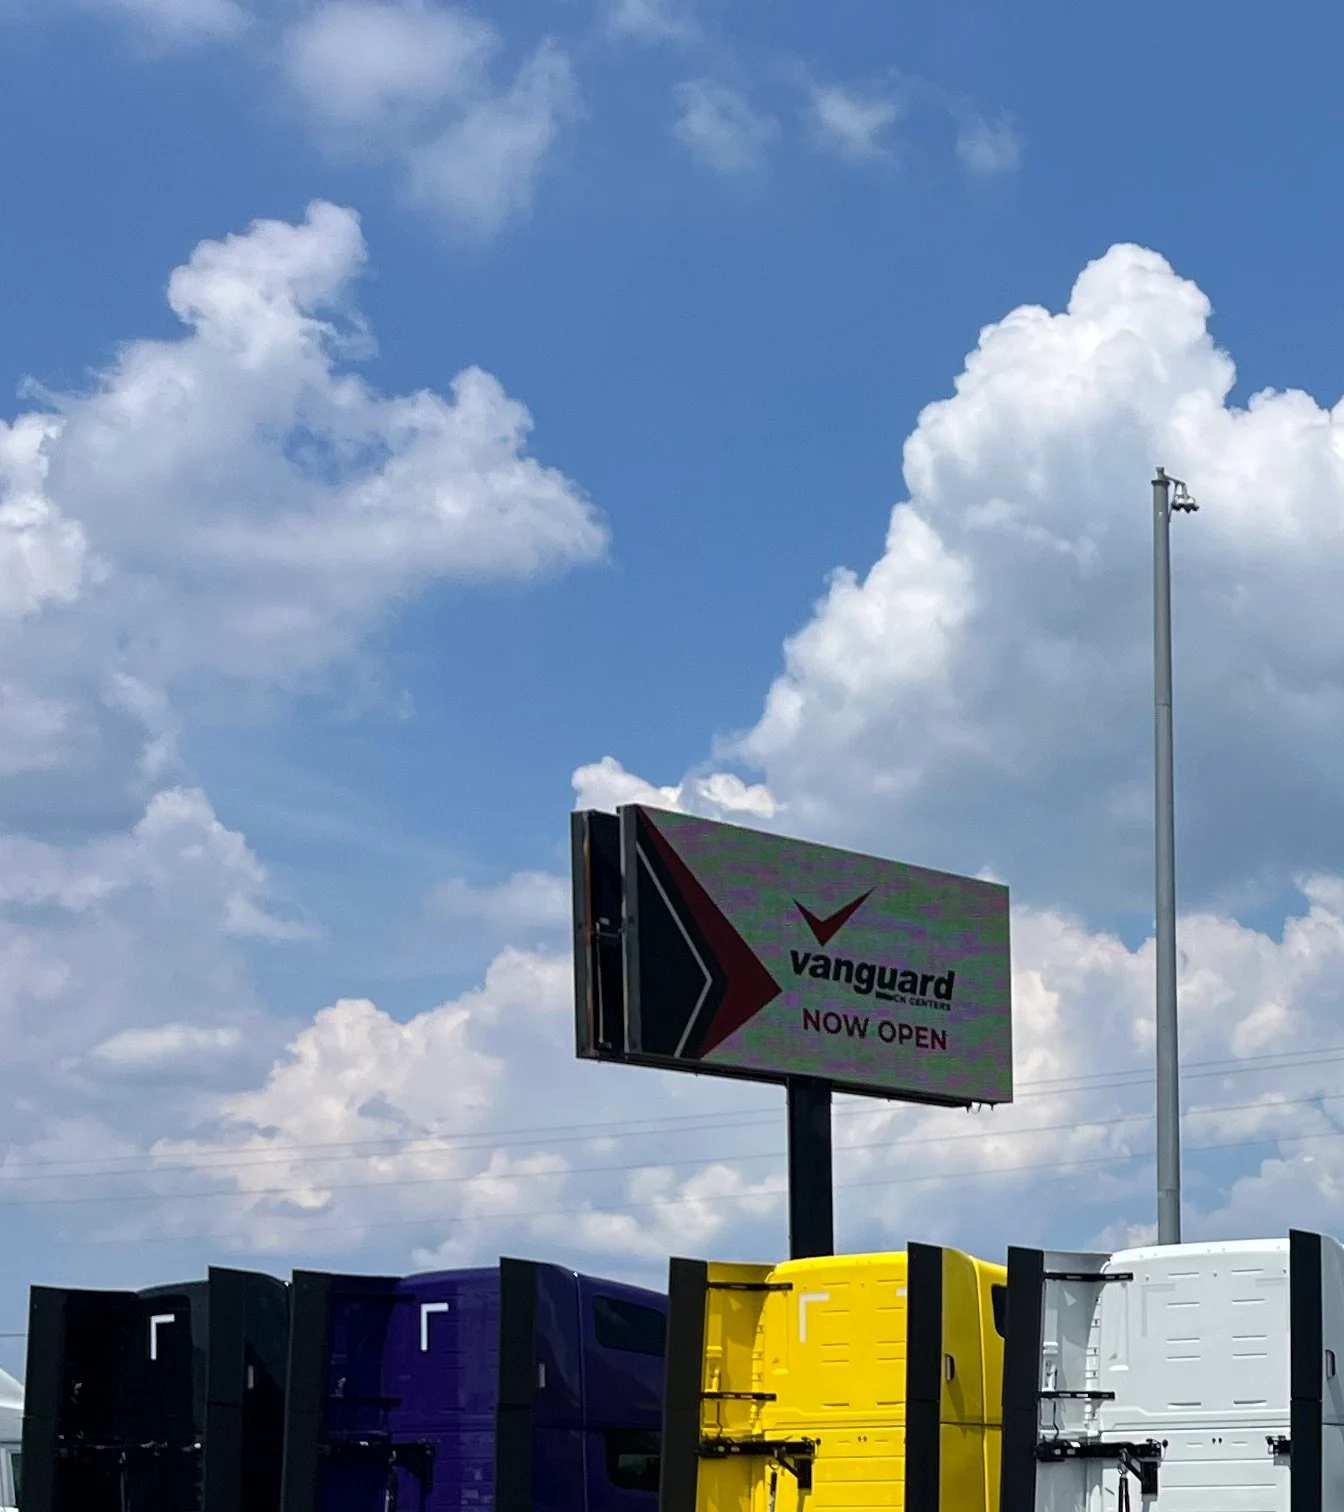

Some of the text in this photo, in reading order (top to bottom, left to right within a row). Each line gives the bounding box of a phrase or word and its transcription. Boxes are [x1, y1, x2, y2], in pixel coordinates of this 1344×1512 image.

[789, 949, 956, 1001] vanguard
[802, 1007, 948, 1051] NOW OPEN
